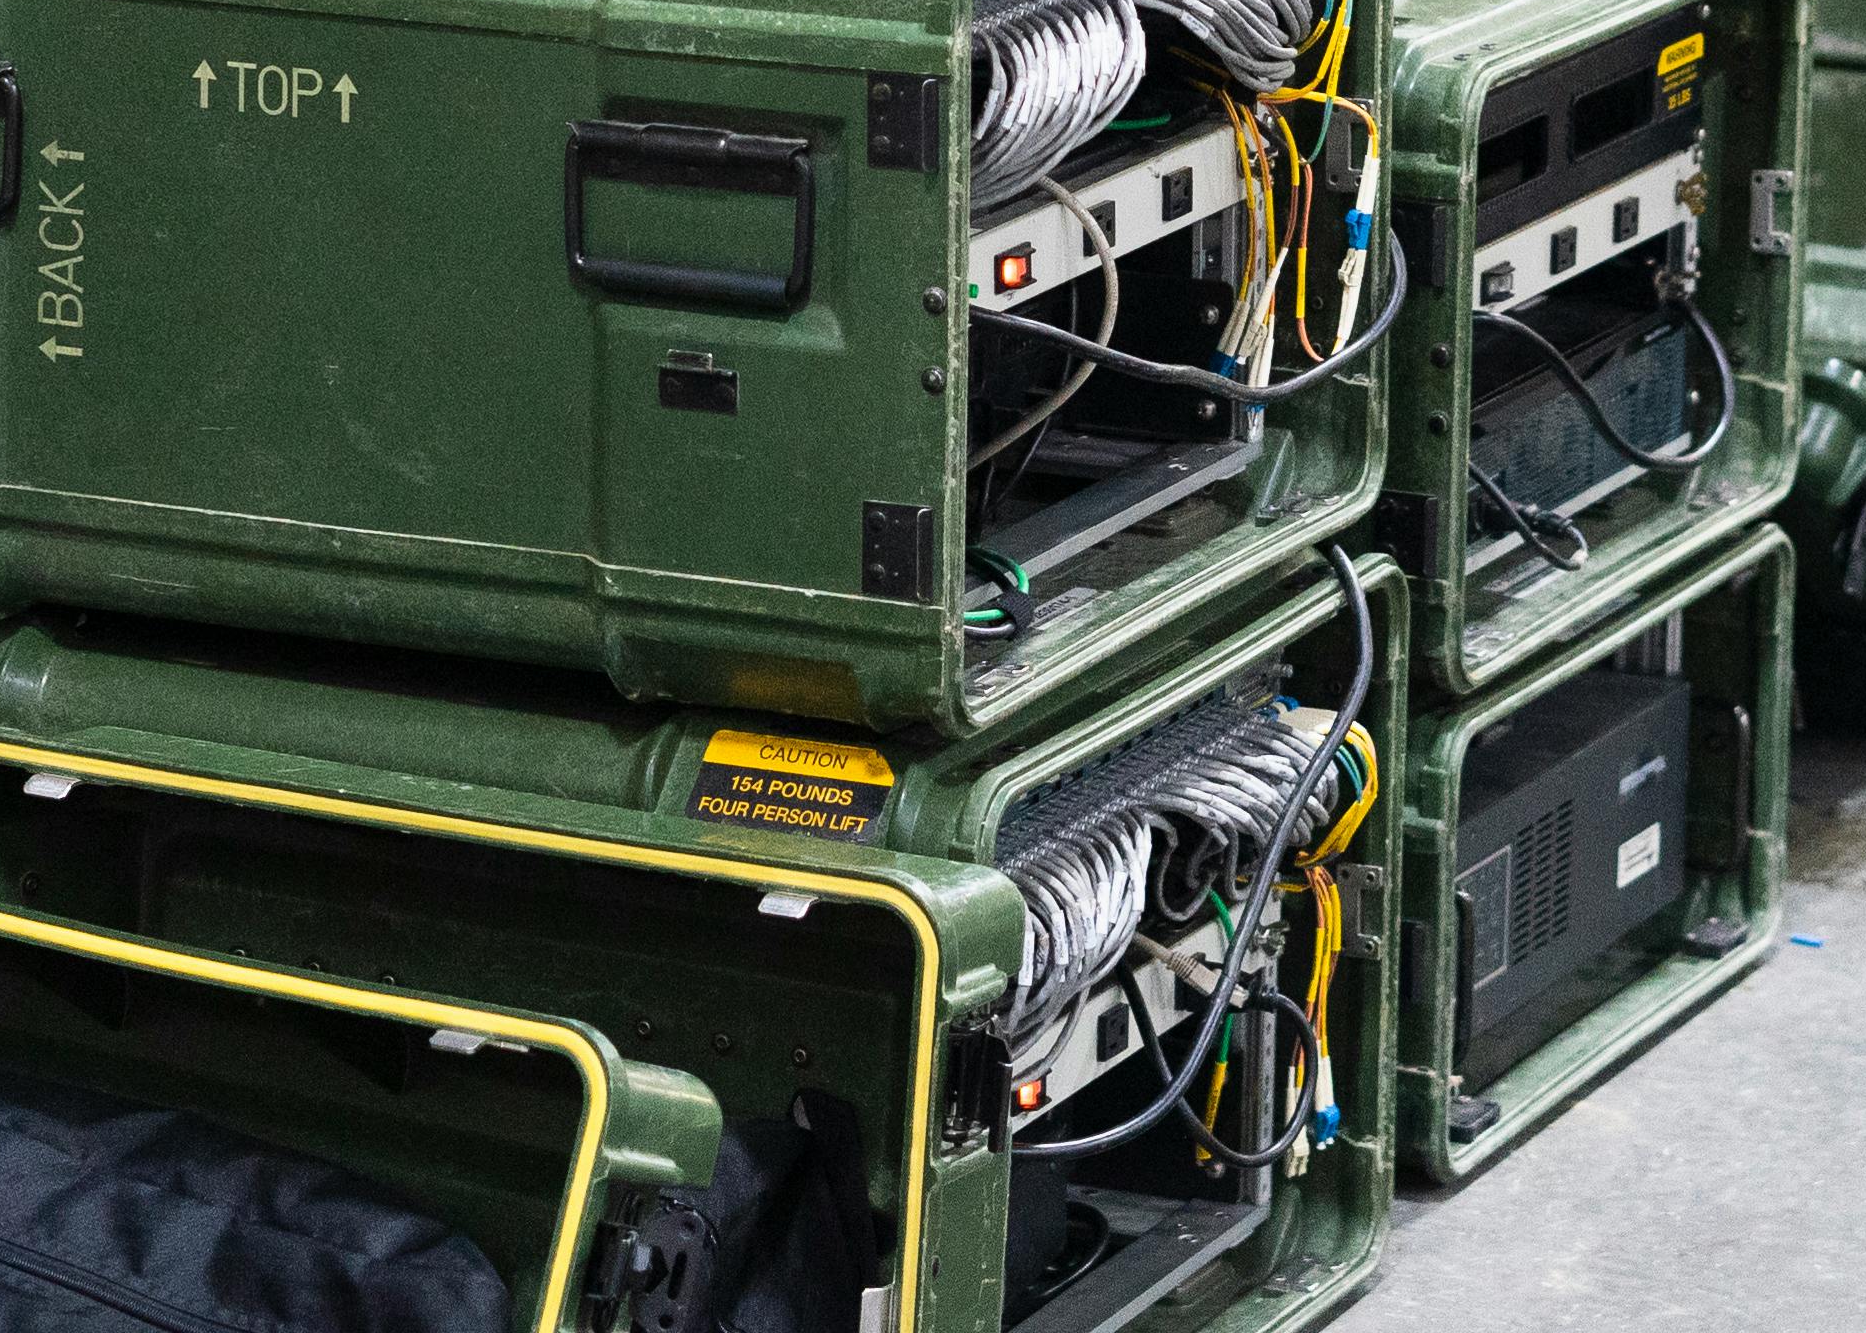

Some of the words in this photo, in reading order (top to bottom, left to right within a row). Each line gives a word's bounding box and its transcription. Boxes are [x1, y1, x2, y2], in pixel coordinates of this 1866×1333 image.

[227, 60, 323, 118] TOP
[38, 180, 84, 328] BACK
[759, 744, 849, 770] CAUTION
[732, 775, 763, 792] 154
[768, 780, 854, 806] POUNDS
[698, 796, 750, 818] FOUR
[752, 803, 826, 829] PERSON
[829, 814, 869, 834] LIFT
